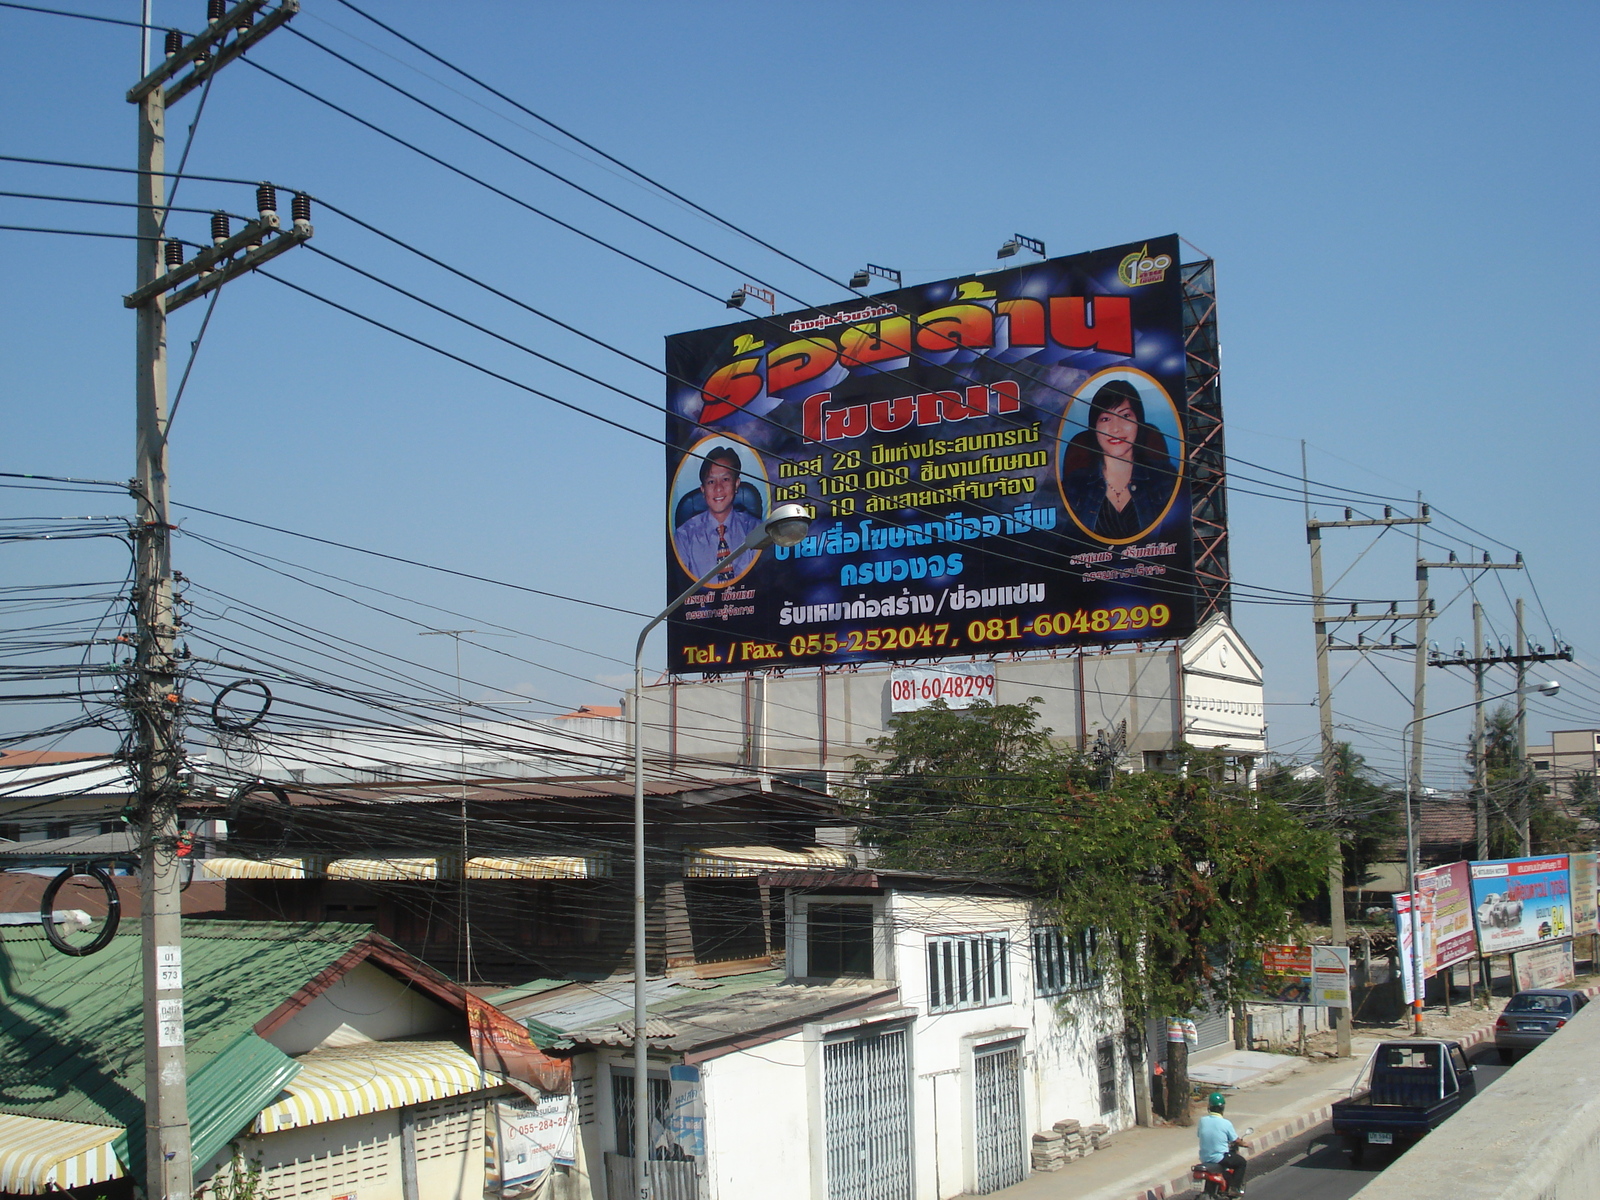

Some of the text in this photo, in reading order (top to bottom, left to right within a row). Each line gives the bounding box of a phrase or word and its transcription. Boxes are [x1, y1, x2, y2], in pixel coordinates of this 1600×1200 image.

[1128, 256, 1170, 284] 100
[698, 281, 1135, 426] ร้อยล้าน
[802, 380, 1021, 444] โฆษณา
[832, 450, 861, 471] 20
[871, 421, 1042, 465] ปีแห่งประสบการณ์
[920, 449, 1047, 483] ชิ้นงานโฆษณา
[830, 497, 855, 518] 10
[840, 552, 963, 586] ครบวงจร
[779, 582, 1046, 626] รับเหมาก่อสร้าง/ซ่อมแซม
[683, 604, 1170, 664] Tel. / Fax. 055-252047, 081-6048299
[892, 674, 995, 701] 081-6048299
[1551, 904, 1565, 937] 84
[165, 953, 174, 962] 01
[162, 971, 178, 980] 573
